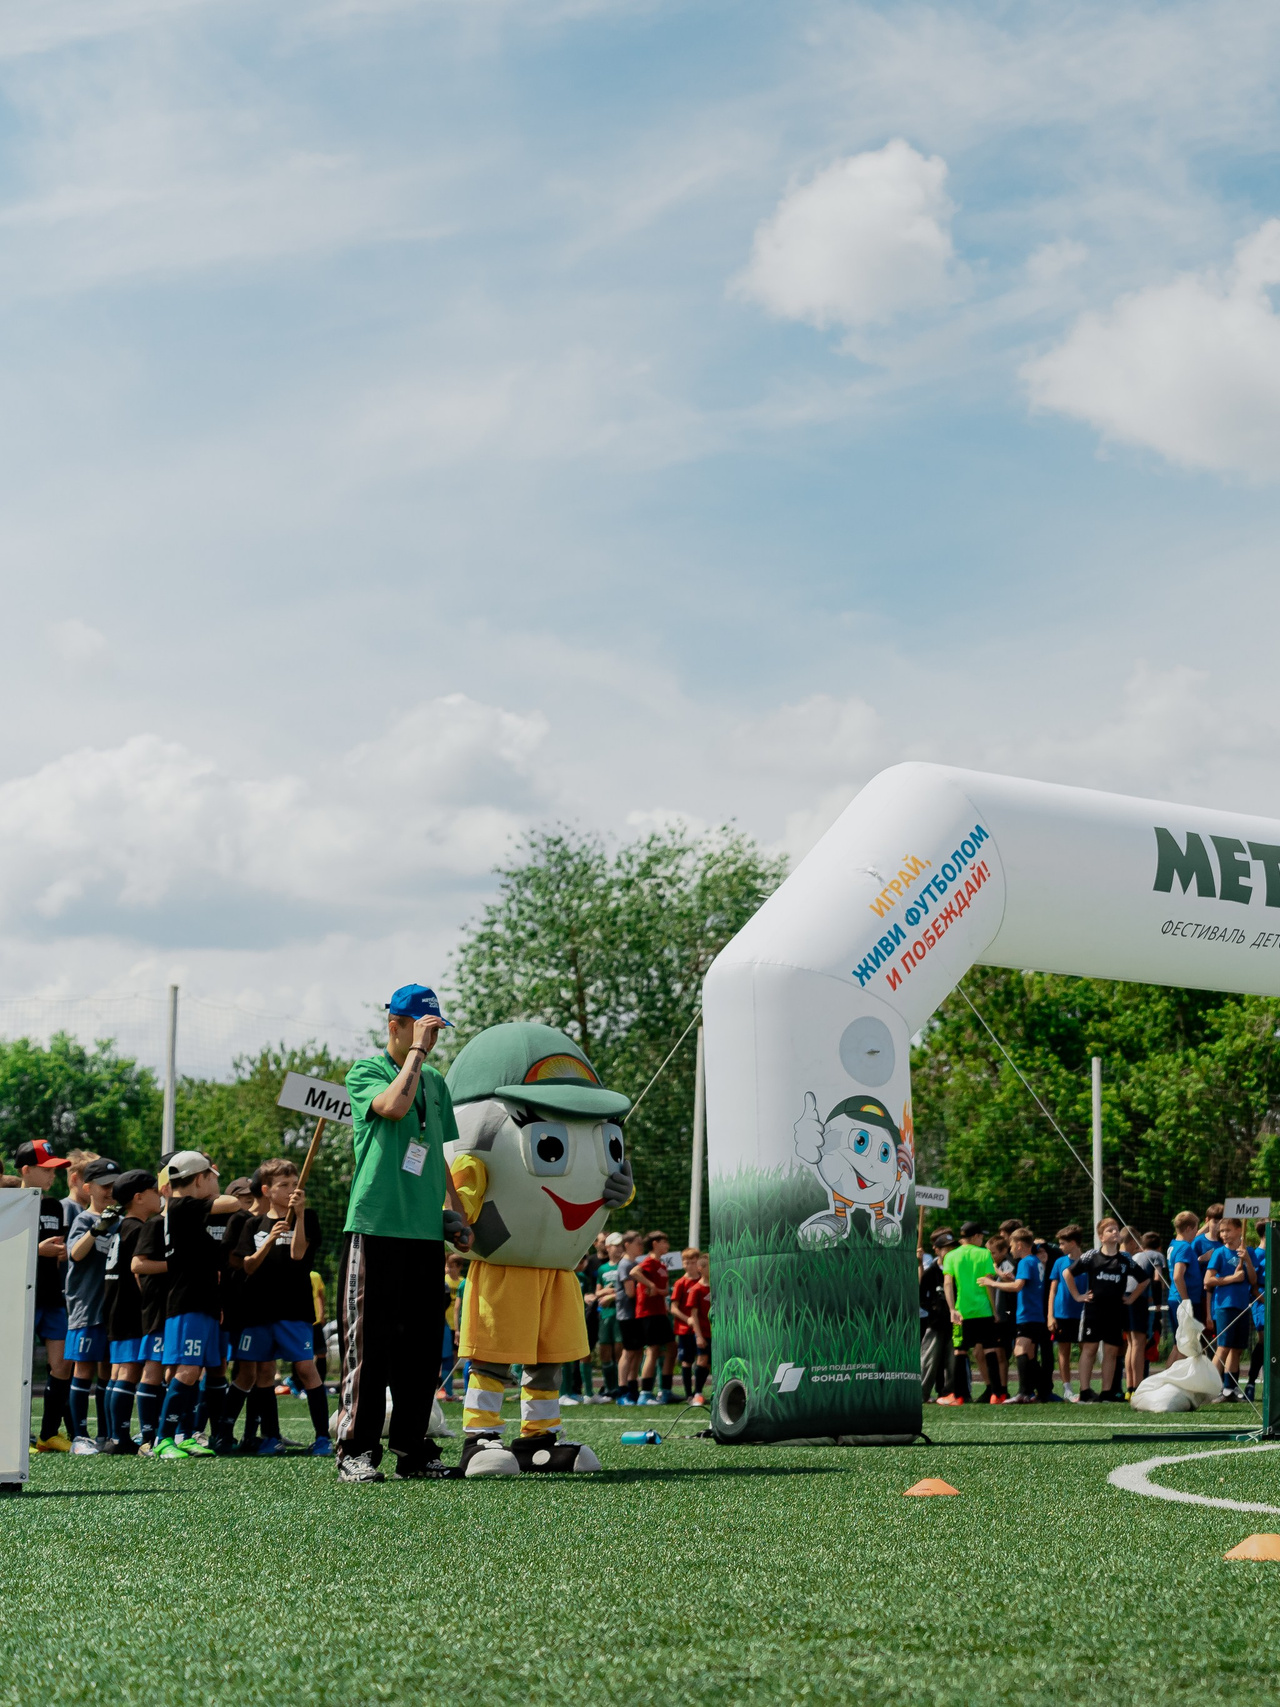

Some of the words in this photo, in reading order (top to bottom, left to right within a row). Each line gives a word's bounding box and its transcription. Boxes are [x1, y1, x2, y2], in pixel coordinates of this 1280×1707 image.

[869, 854, 933, 918] ИГРАЙ,
[852, 923, 907, 987] ЖИВИ
[905, 824, 989, 926] ФУТБОЛОМ
[885, 967, 903, 991] И
[900, 860, 991, 974] ПОБЕЖДАЙ!
[1161, 919, 1246, 944] ФЕСТИВАЛЬ
[304, 1087, 352, 1120] Мир
[1235, 1203, 1259, 1217] Мир
[1096, 1271, 1121, 1284] Jeep
[78, 1336, 93, 1353] 17
[184, 1339, 202, 1357] 35
[829, 1363, 876, 1372] ПОДДЕРЖКЕ
[811, 1373, 851, 1383] ФОНДА
